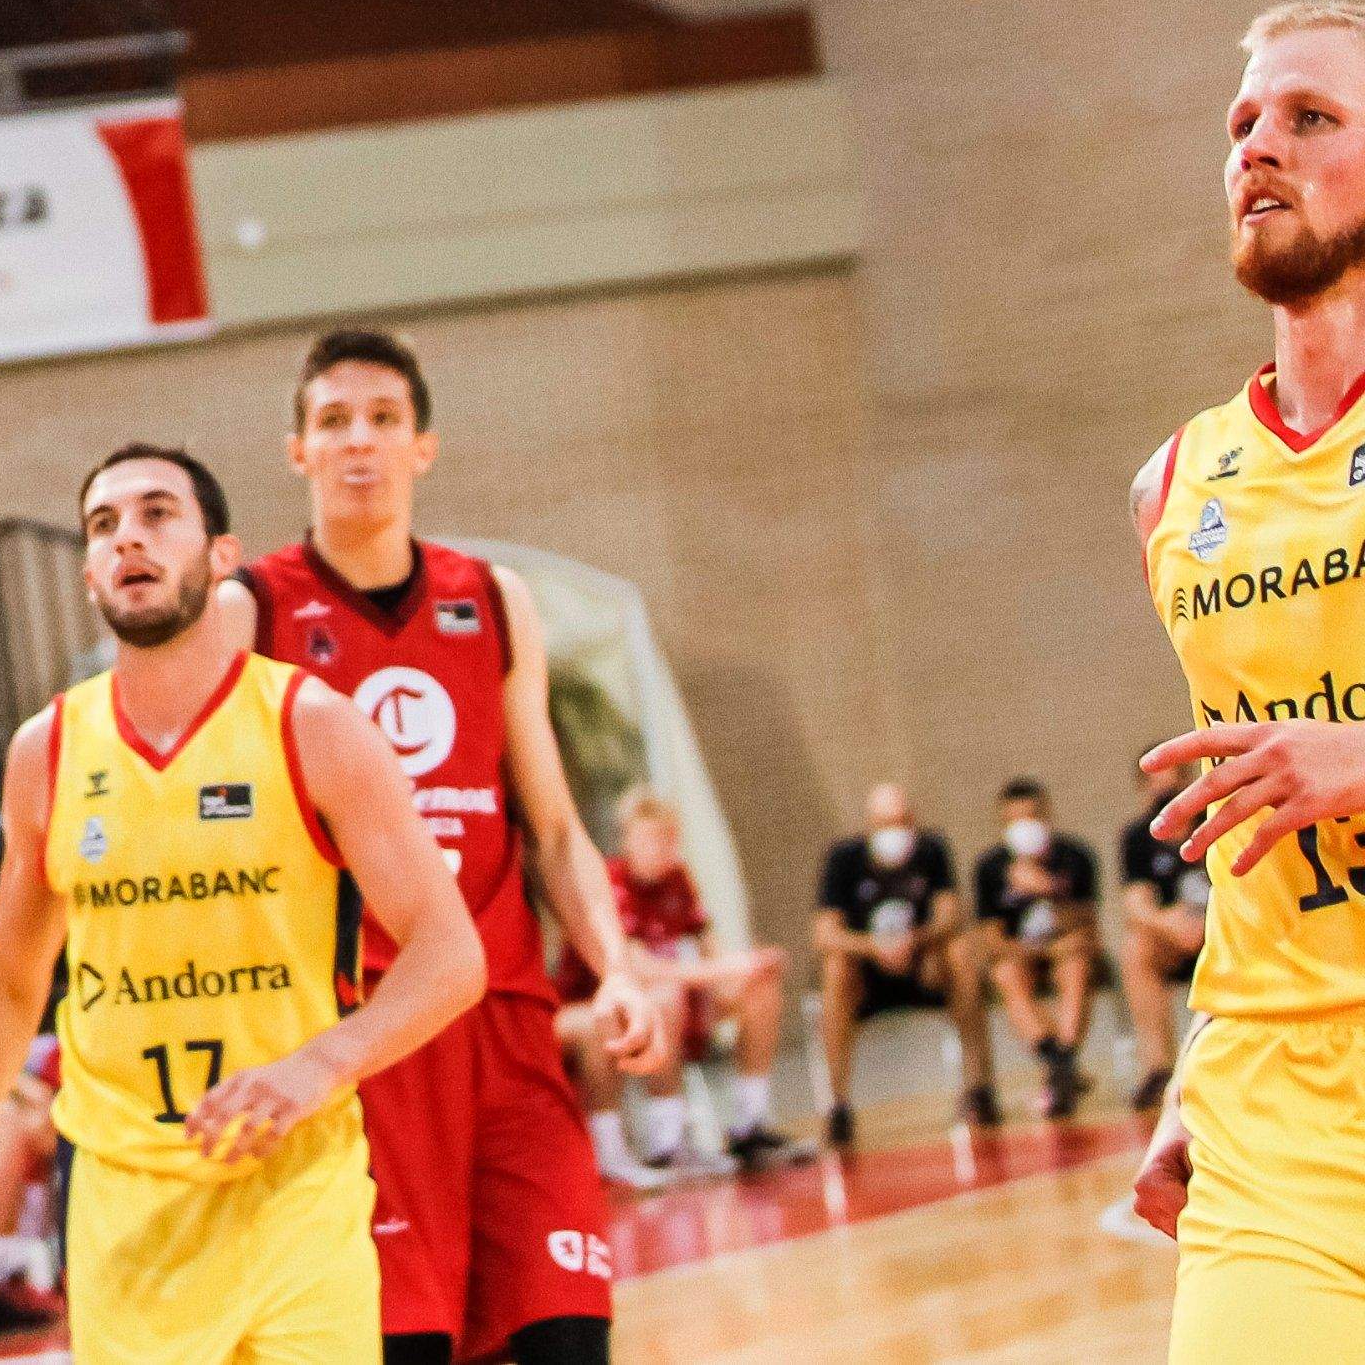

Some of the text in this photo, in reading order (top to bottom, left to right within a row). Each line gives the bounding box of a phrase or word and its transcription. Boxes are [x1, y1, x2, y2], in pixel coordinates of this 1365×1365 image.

[90, 865, 282, 909] MORABANC
[115, 960, 293, 1005] Andorra
[142, 1039, 224, 1124] 17
